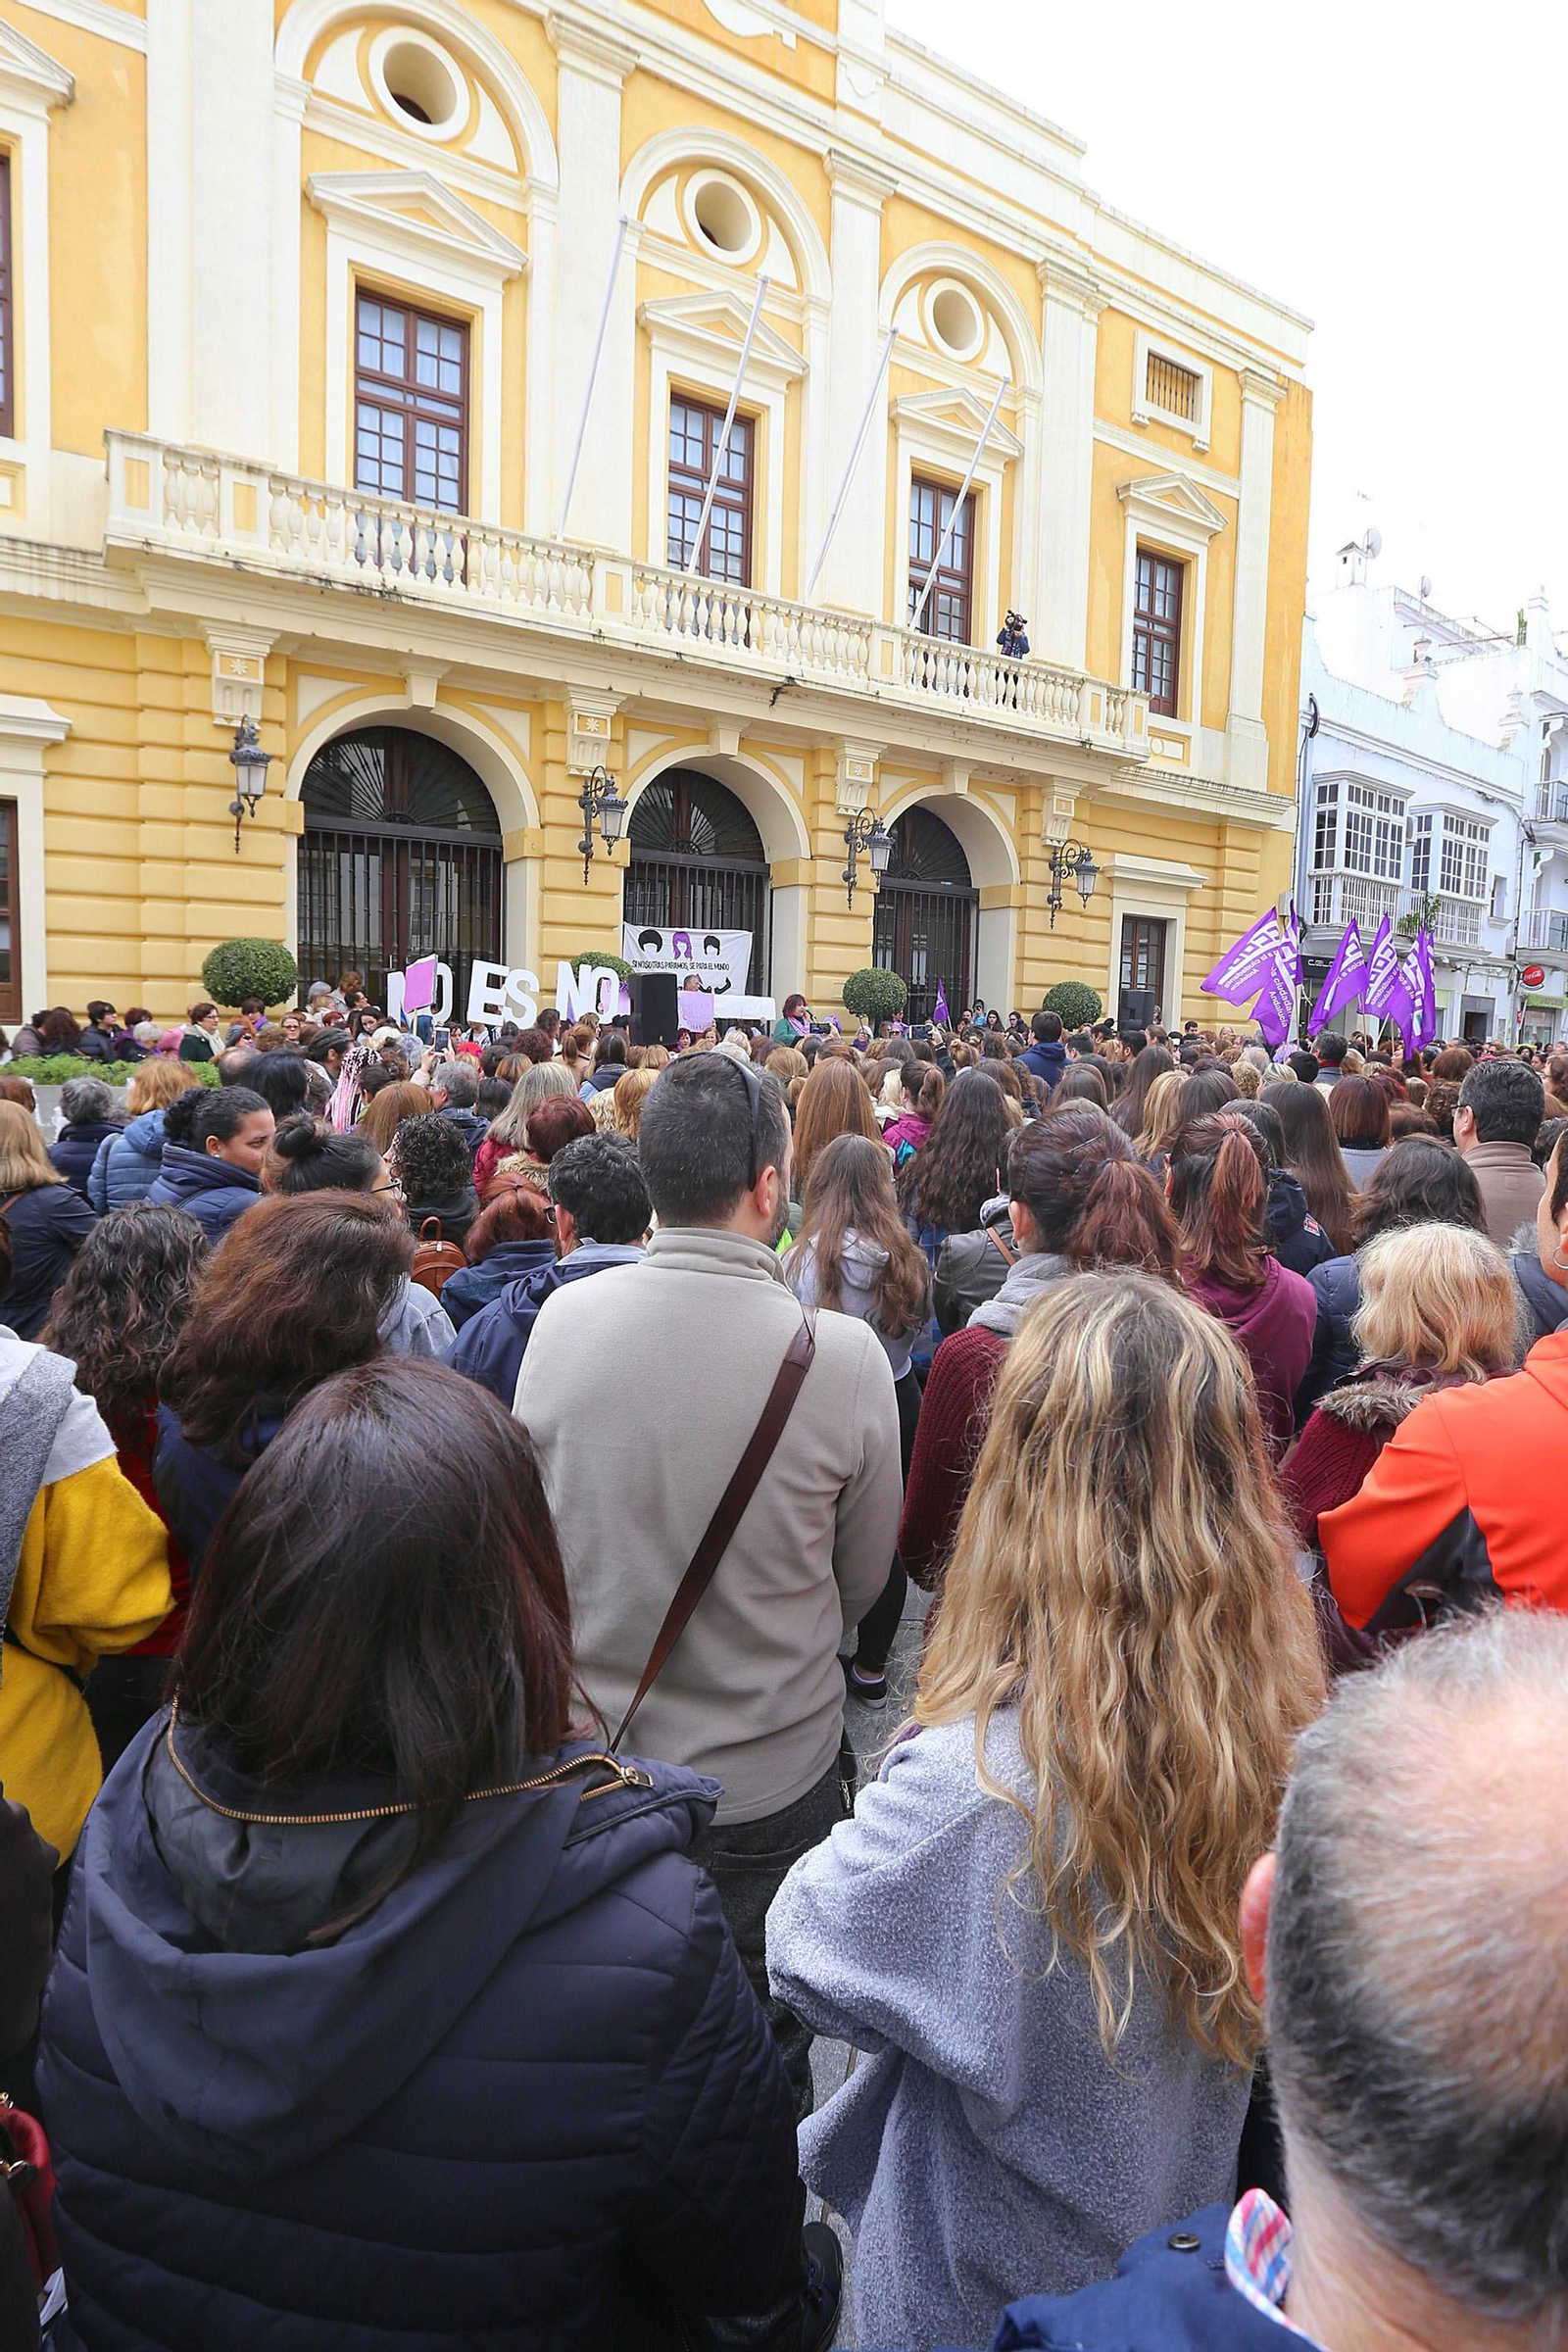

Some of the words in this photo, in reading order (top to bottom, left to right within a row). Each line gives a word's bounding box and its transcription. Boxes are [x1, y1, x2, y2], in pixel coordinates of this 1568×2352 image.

[466, 959, 540, 1030] ES
[555, 960, 619, 1025] NO
[1268, 991, 1289, 1028] Andalucía
